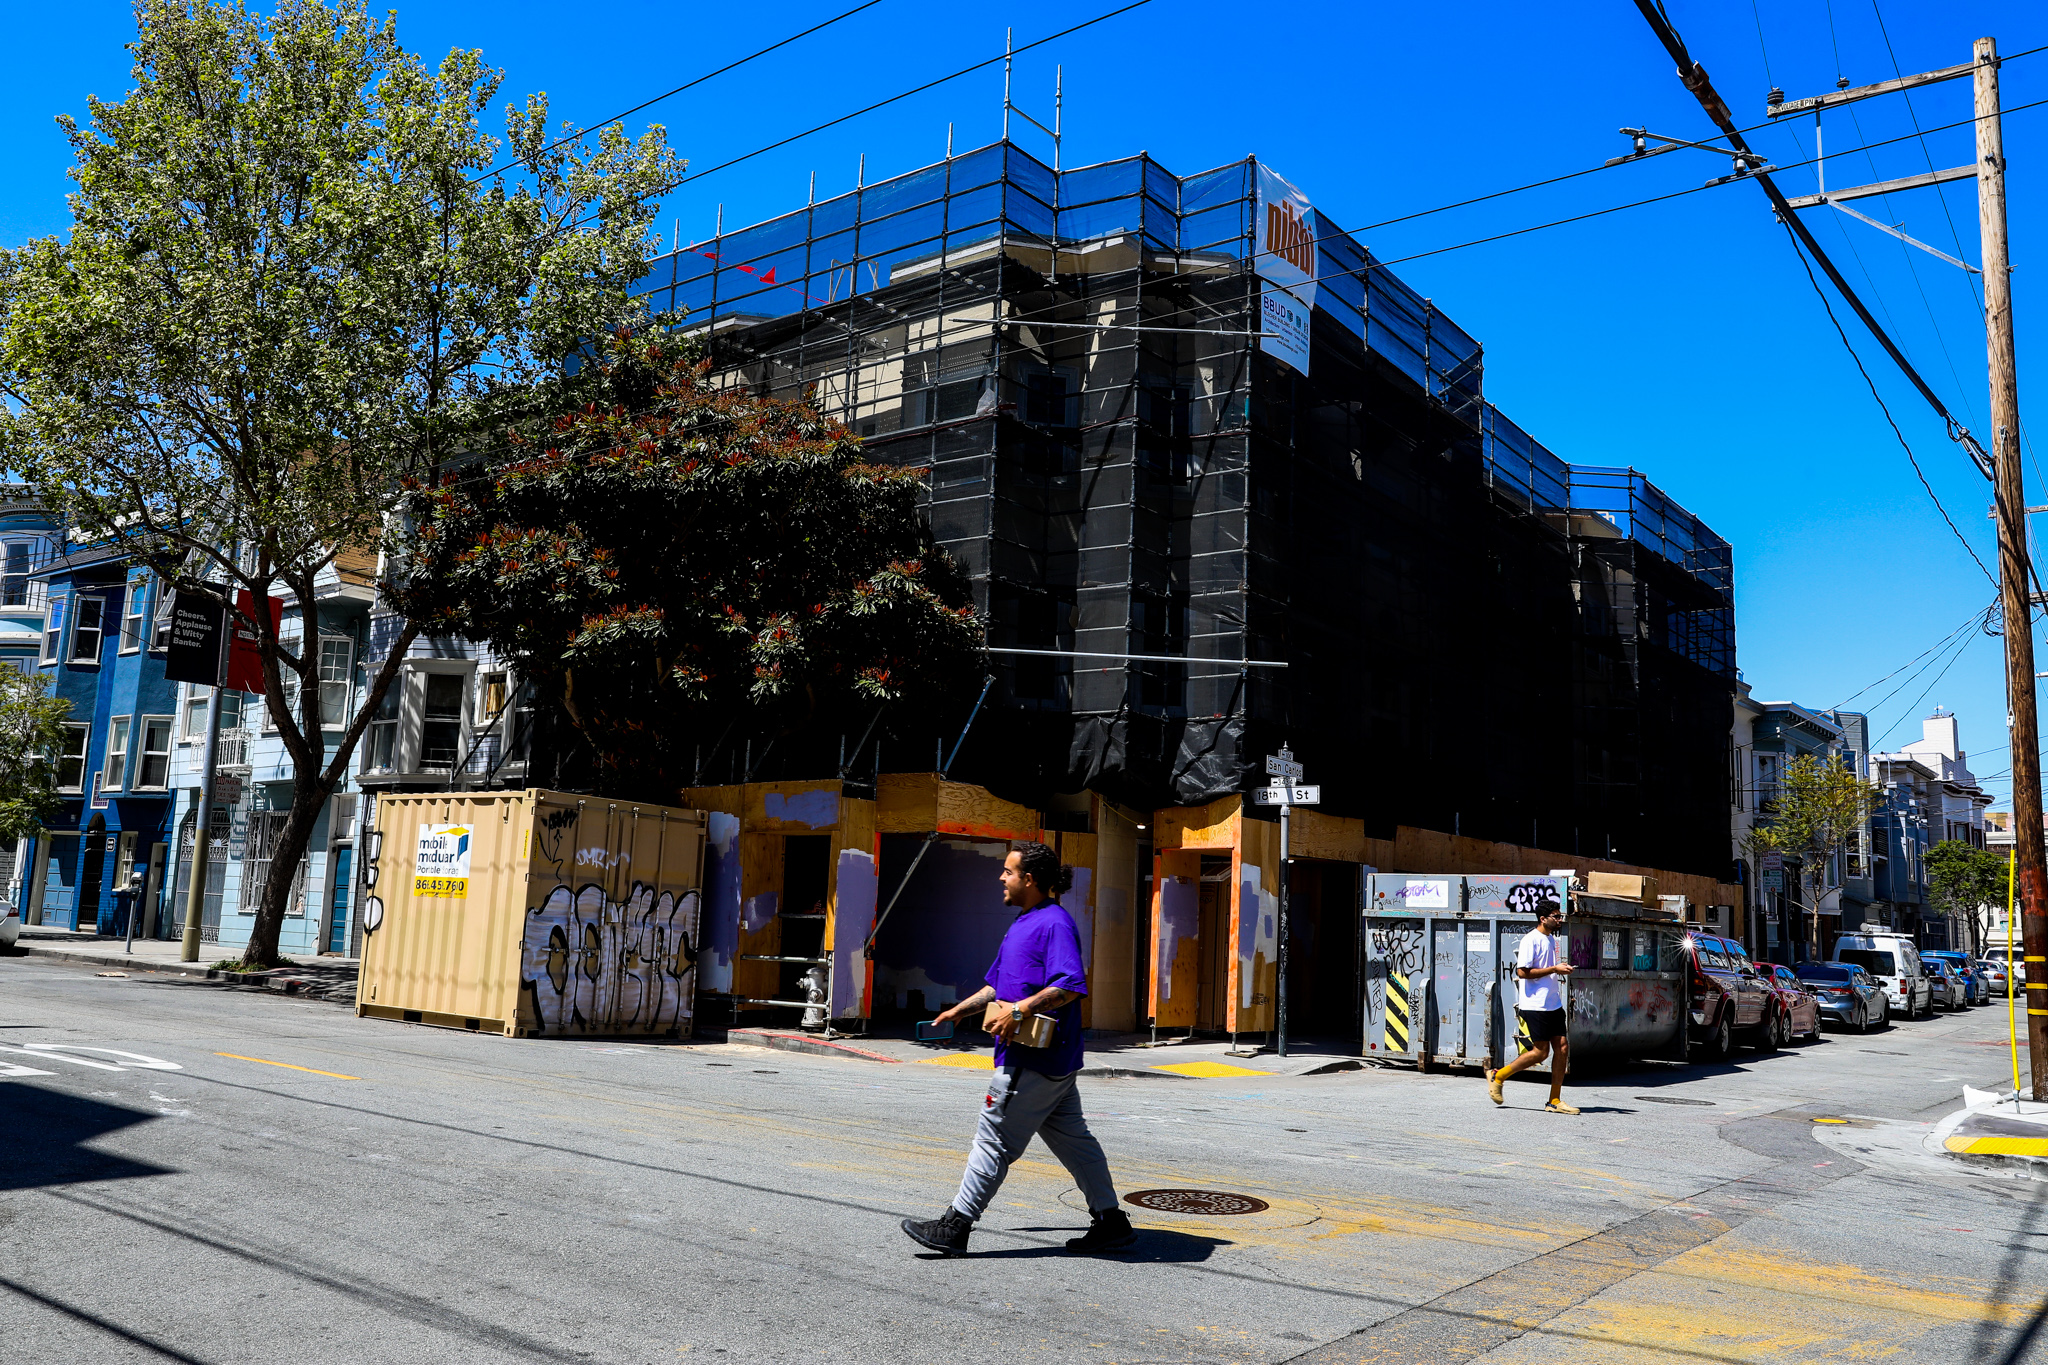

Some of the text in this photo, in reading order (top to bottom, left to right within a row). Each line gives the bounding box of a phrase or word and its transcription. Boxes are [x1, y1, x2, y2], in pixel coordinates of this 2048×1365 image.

[1266, 199, 1315, 279] nibbi
[1263, 295, 1287, 319] BBUD
[176, 609, 207, 621] Cheers,
[175, 619, 213, 631] Applause
[174, 627, 205, 640] & Witty
[173, 637, 202, 648] Banter.
[1268, 760, 1302, 778] San Carlos
[1257, 790, 1309, 801] 18th St
[417, 850, 455, 863] mduar
[415, 879, 465, 892] 86.45.760
